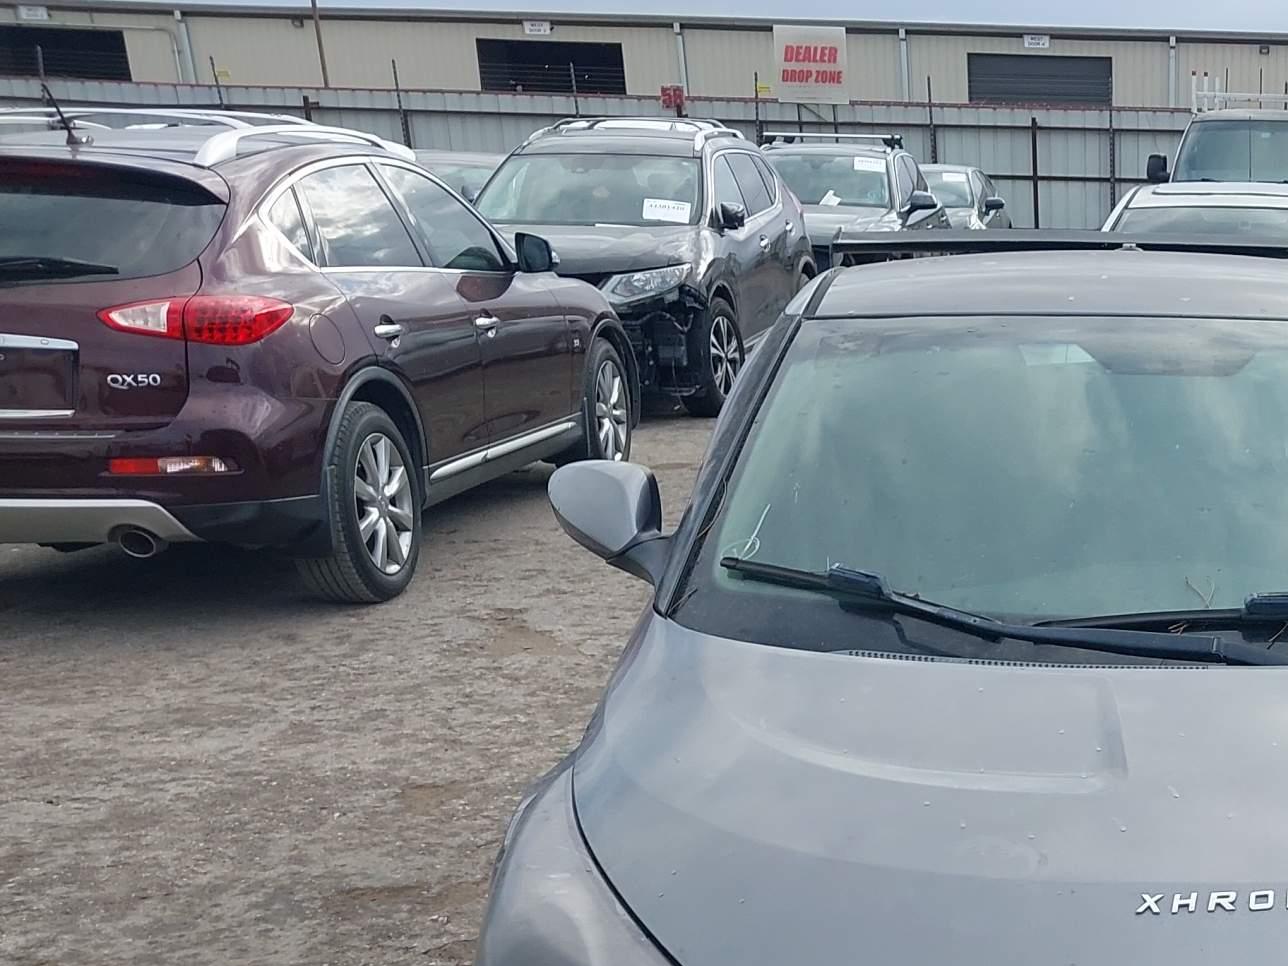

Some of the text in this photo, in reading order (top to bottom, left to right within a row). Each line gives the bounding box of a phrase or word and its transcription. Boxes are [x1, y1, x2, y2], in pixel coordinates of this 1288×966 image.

[783, 44, 838, 64] DEALER
[781, 68, 843, 84] DROP ZONE
[106, 373, 161, 389] QX50
